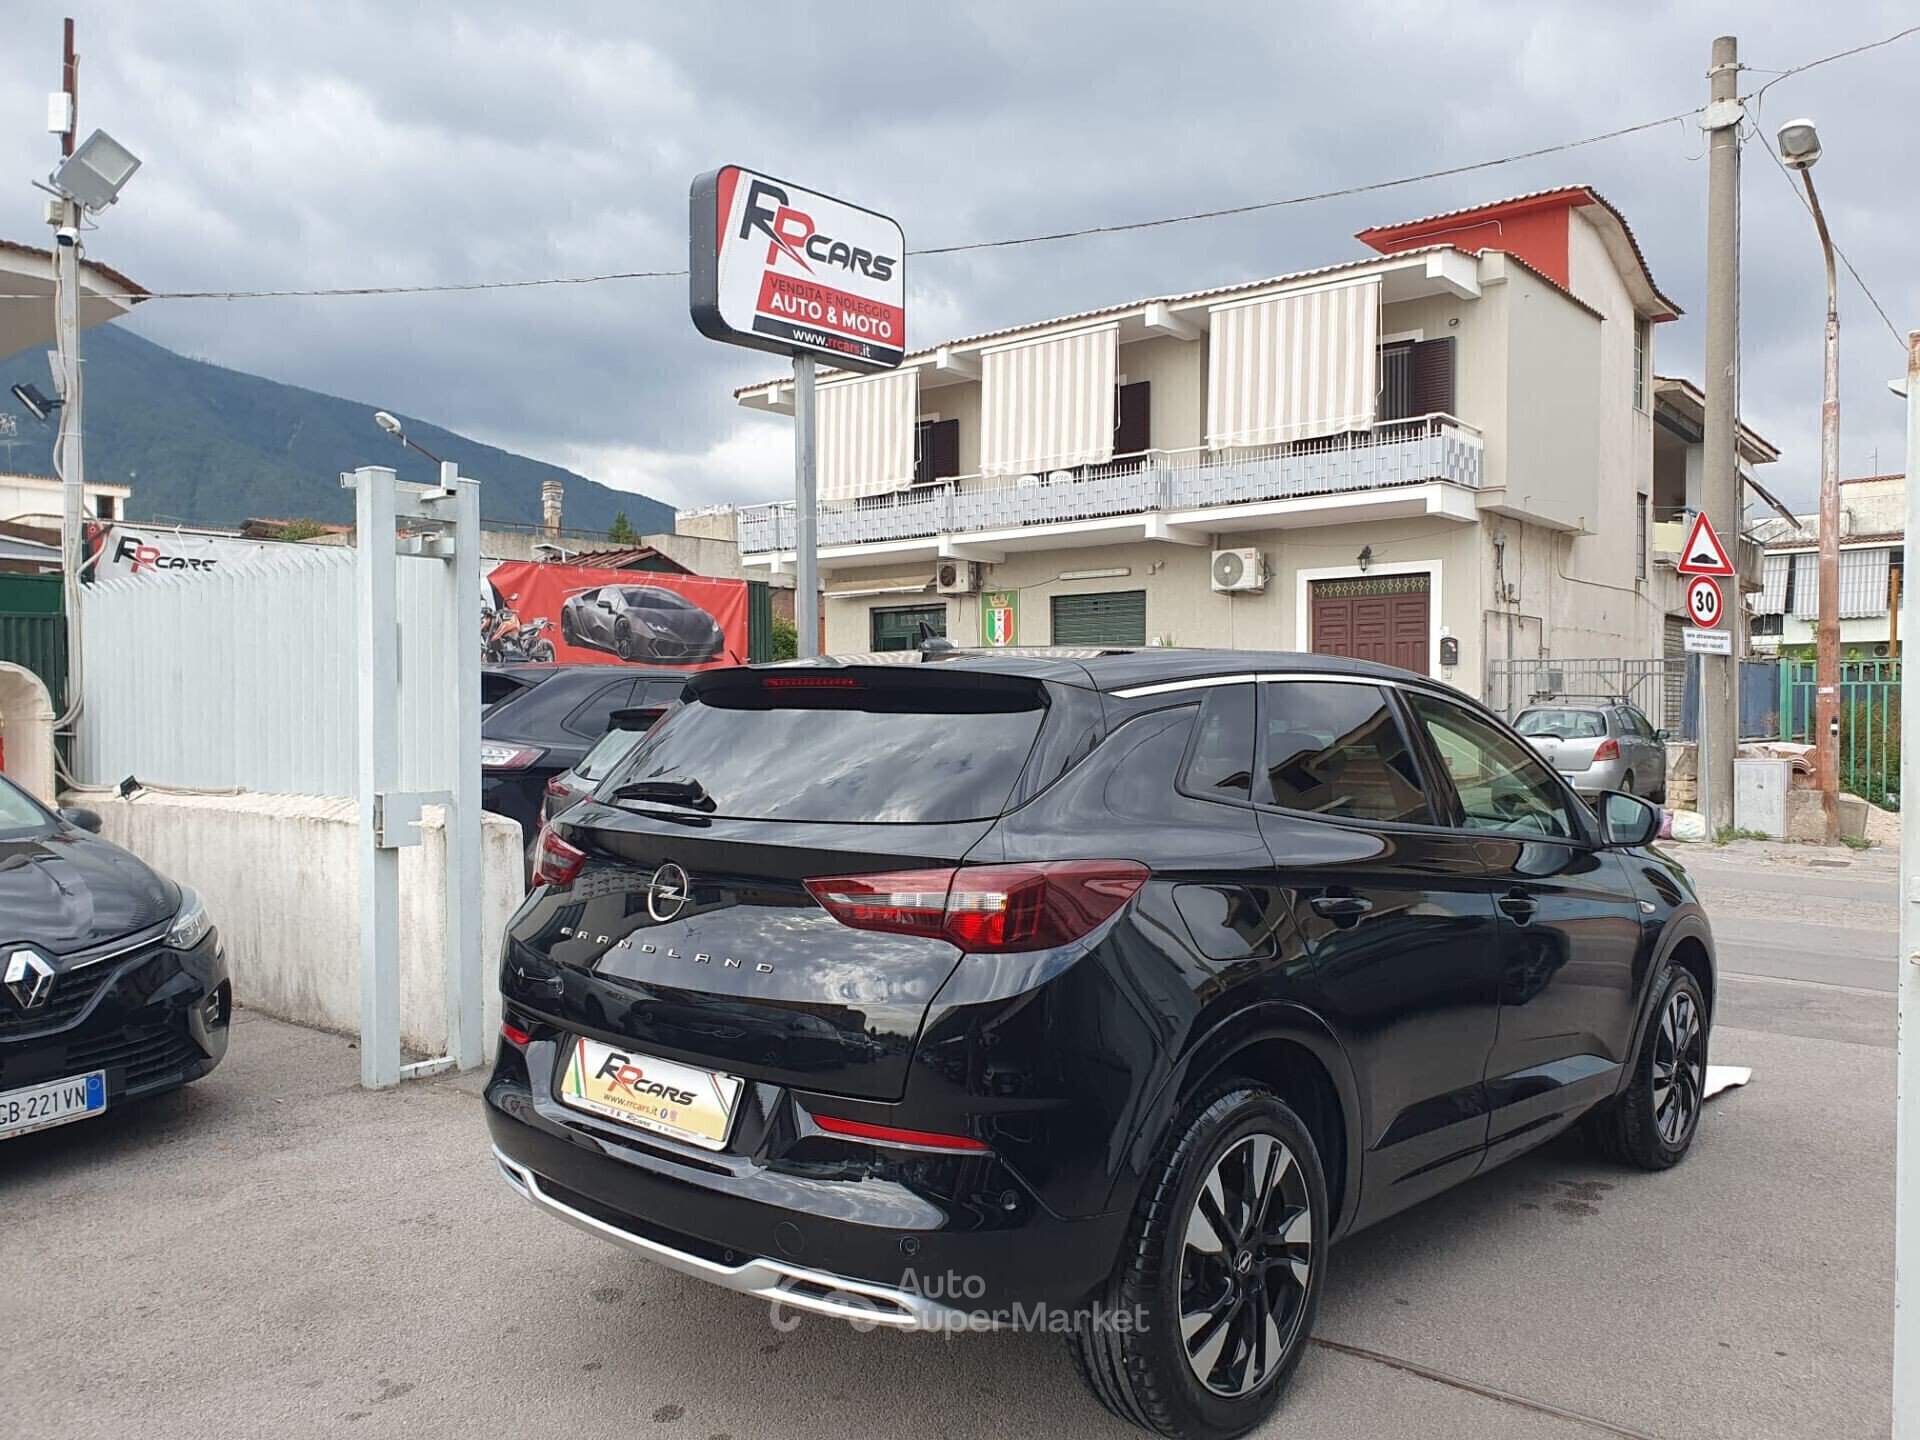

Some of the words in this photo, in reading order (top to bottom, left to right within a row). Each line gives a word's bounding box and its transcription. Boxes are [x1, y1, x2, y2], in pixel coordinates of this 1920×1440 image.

[770, 276, 822, 301] VENDITA
[826, 293, 832, 305] E
[835, 296, 891, 320] NOLEGGIO
[770, 292, 822, 320] AUTO
[826, 304, 838, 325] &
[842, 314, 892, 338] MOTO
[793, 328, 871, 358] www.rrcars.it
[1695, 590, 1715, 613] 30
[560, 926, 775, 974] GRANDLAND
[603, 1092, 659, 1117] www.rrcars.it
